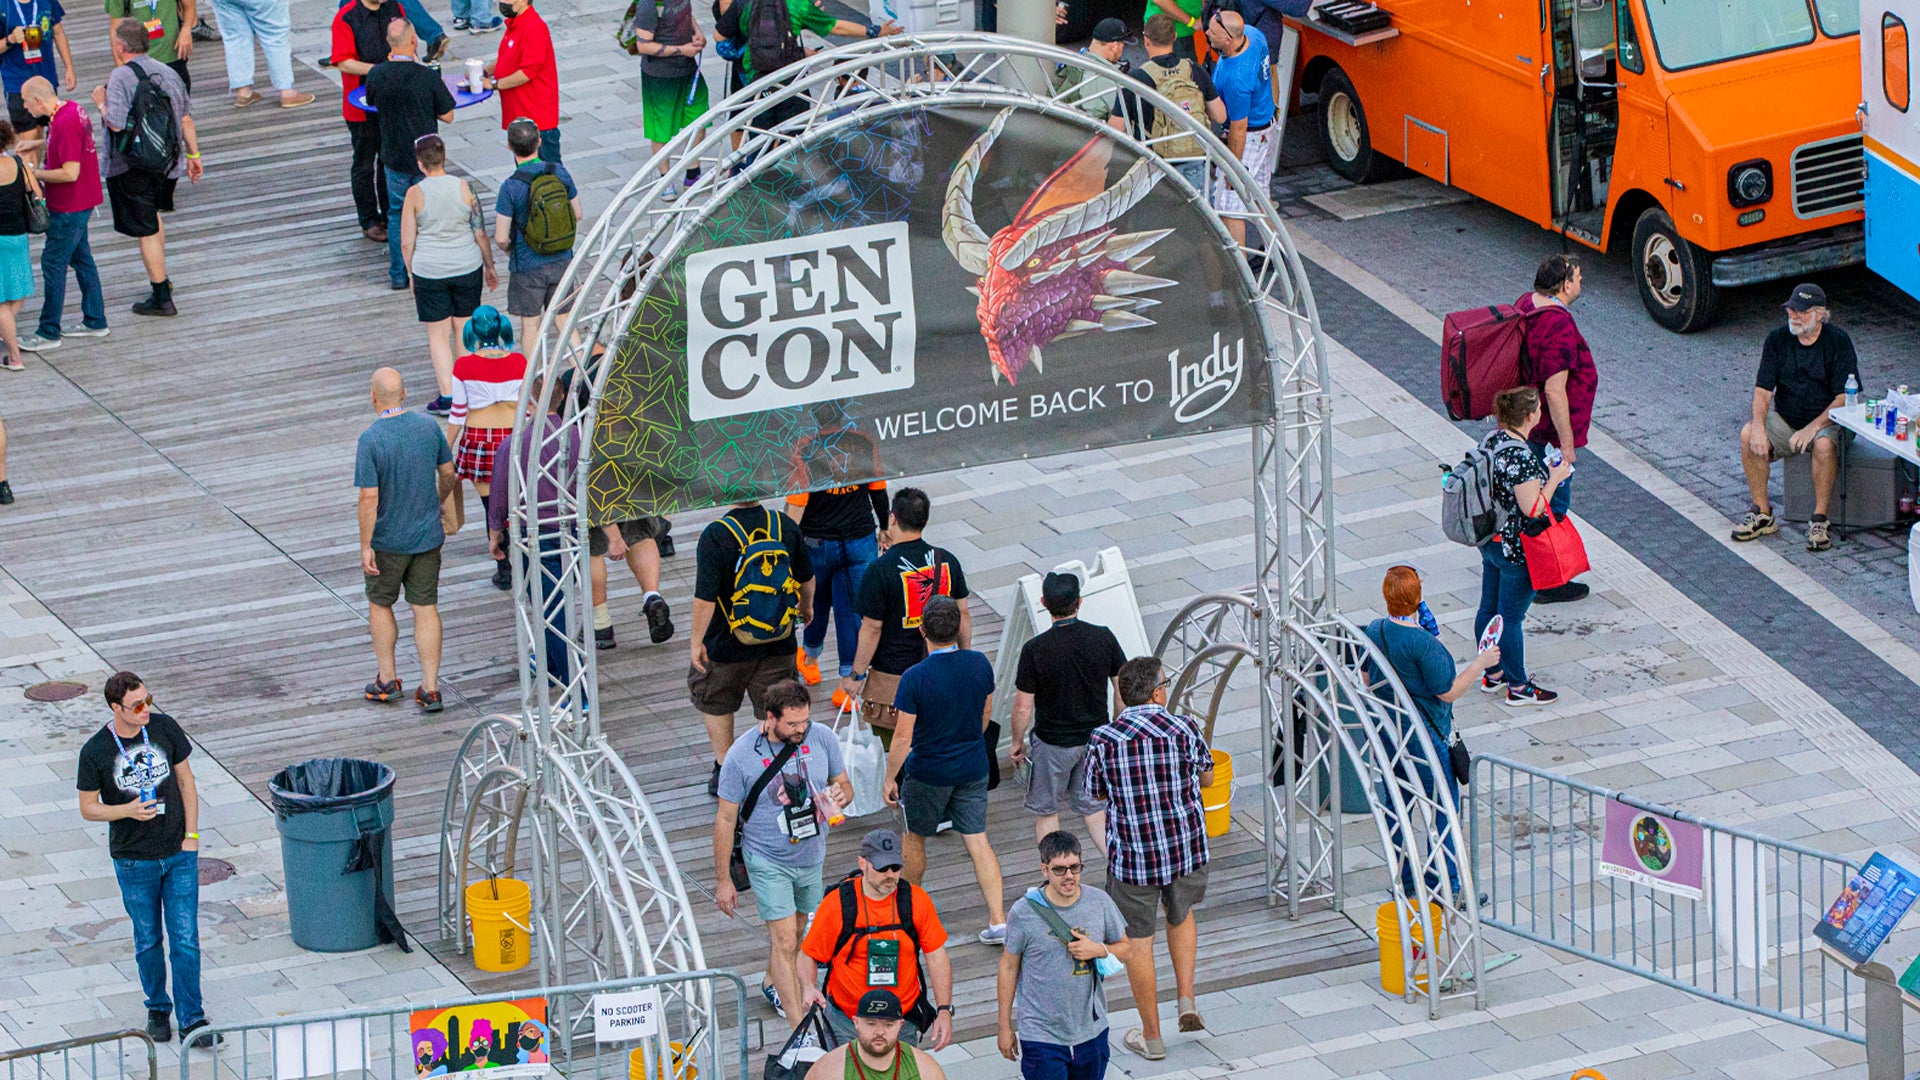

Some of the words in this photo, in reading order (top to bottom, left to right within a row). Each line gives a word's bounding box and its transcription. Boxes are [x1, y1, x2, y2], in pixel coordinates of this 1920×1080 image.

[700, 238, 896, 330] GEN
[1168, 332, 1244, 423] Indy
[875, 397, 1019, 440] WELCOME
[1030, 385, 1106, 417] BACK
[1115, 379, 1154, 405] TO
[881, 839, 893, 851] C
[601, 1007, 614, 1016] NO
[615, 1002, 653, 1015] SCOOTER
[867, 1000, 889, 1013] P
[609, 1016, 646, 1028] PARKING
